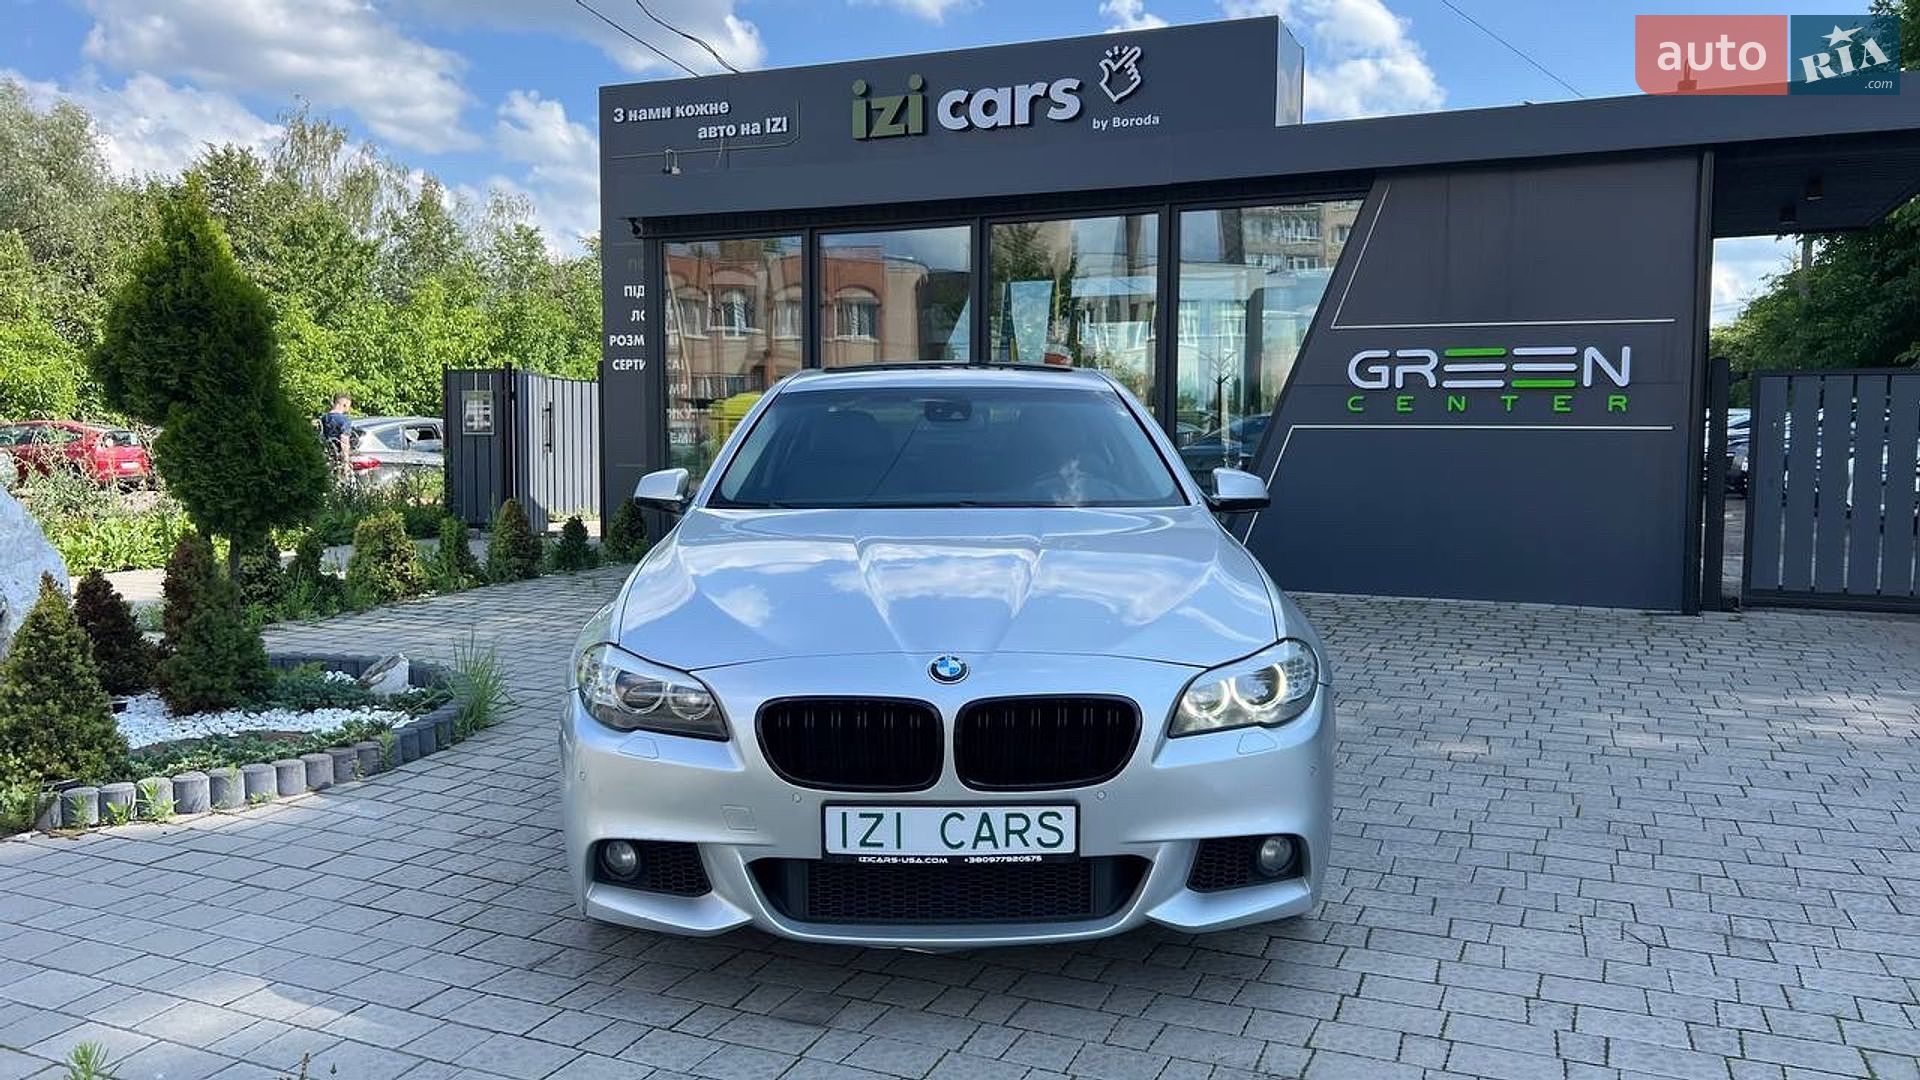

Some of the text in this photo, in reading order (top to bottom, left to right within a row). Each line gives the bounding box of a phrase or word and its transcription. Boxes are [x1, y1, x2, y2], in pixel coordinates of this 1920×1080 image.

[613, 101, 730, 123] З нами кожне
[852, 73, 1081, 140] izi cars
[697, 124, 737, 140] авто
[740, 122, 761, 136] на
[1092, 114, 1160, 130] by Boroda
[1348, 346, 1632, 389] GREEN
[1347, 395, 1628, 412] CENTER
[841, 811, 1065, 850] IZI CARS
